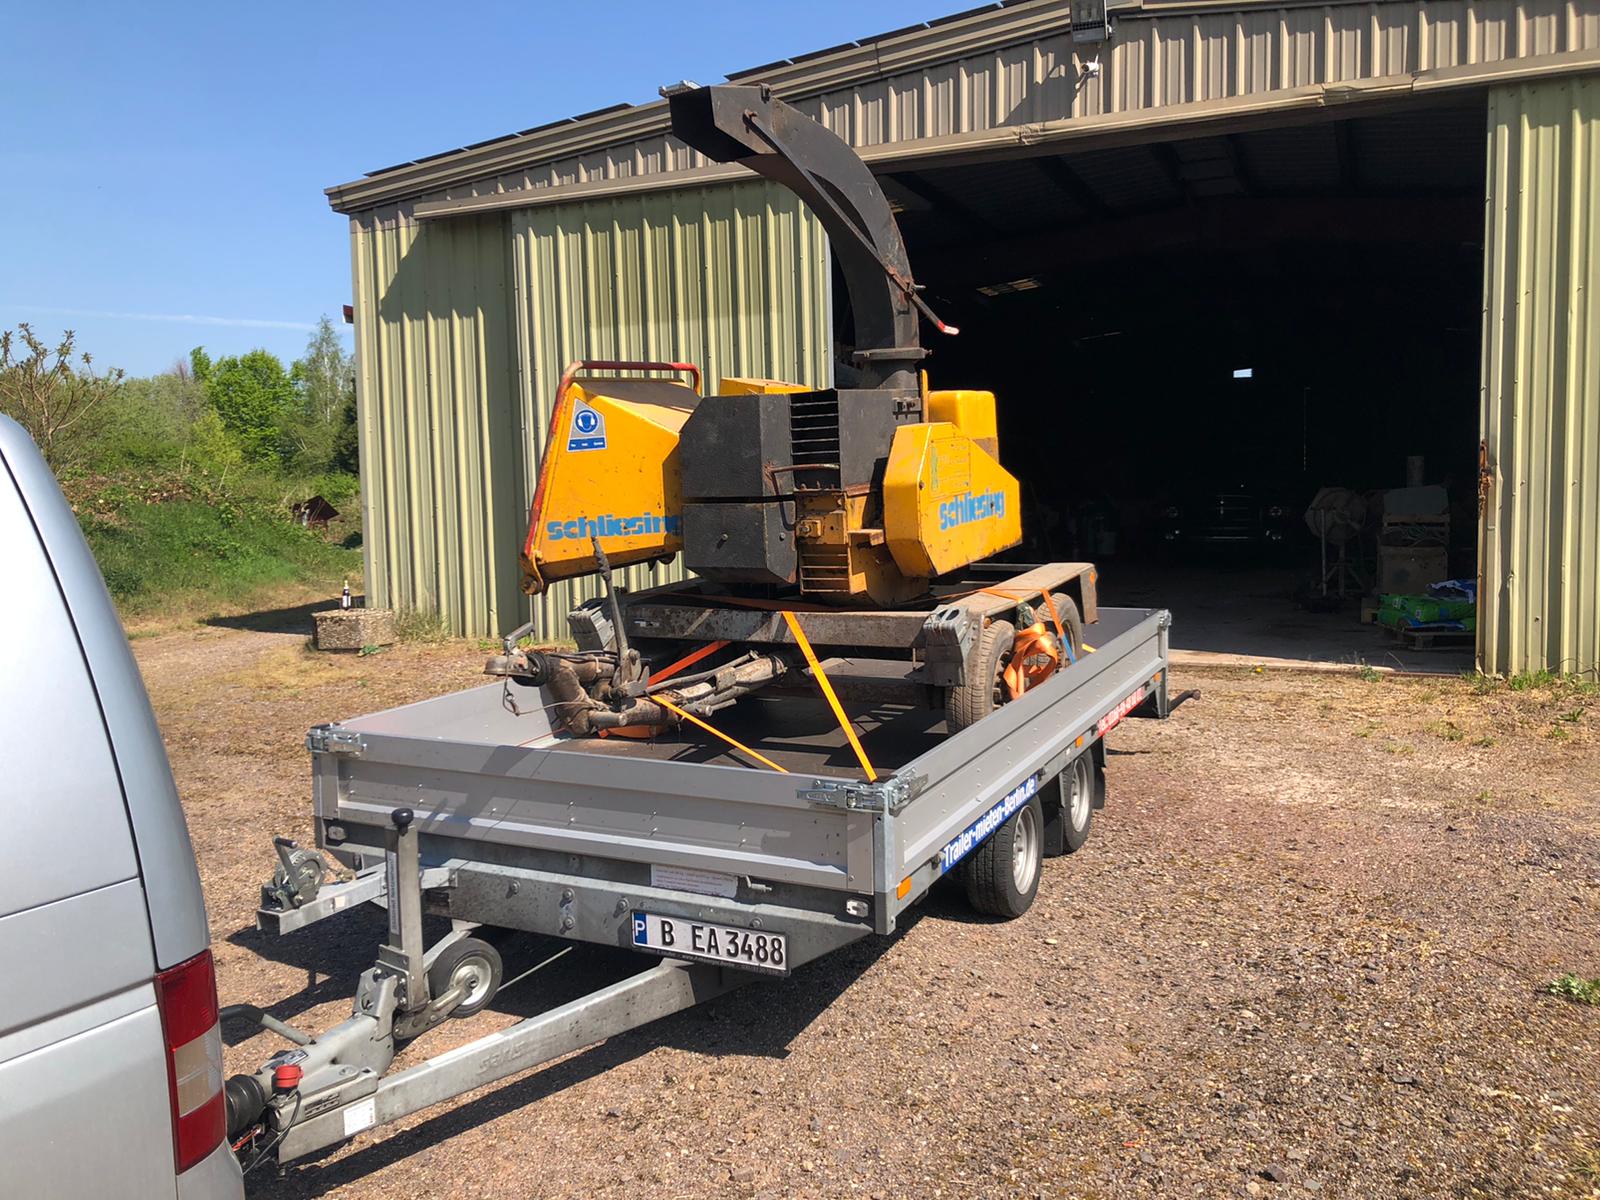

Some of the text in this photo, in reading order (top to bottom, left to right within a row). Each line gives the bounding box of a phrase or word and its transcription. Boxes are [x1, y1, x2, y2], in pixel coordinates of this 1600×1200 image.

[635, 920, 645, 936] P
[661, 920, 675, 946] B
[725, 931, 784, 965] 3488
